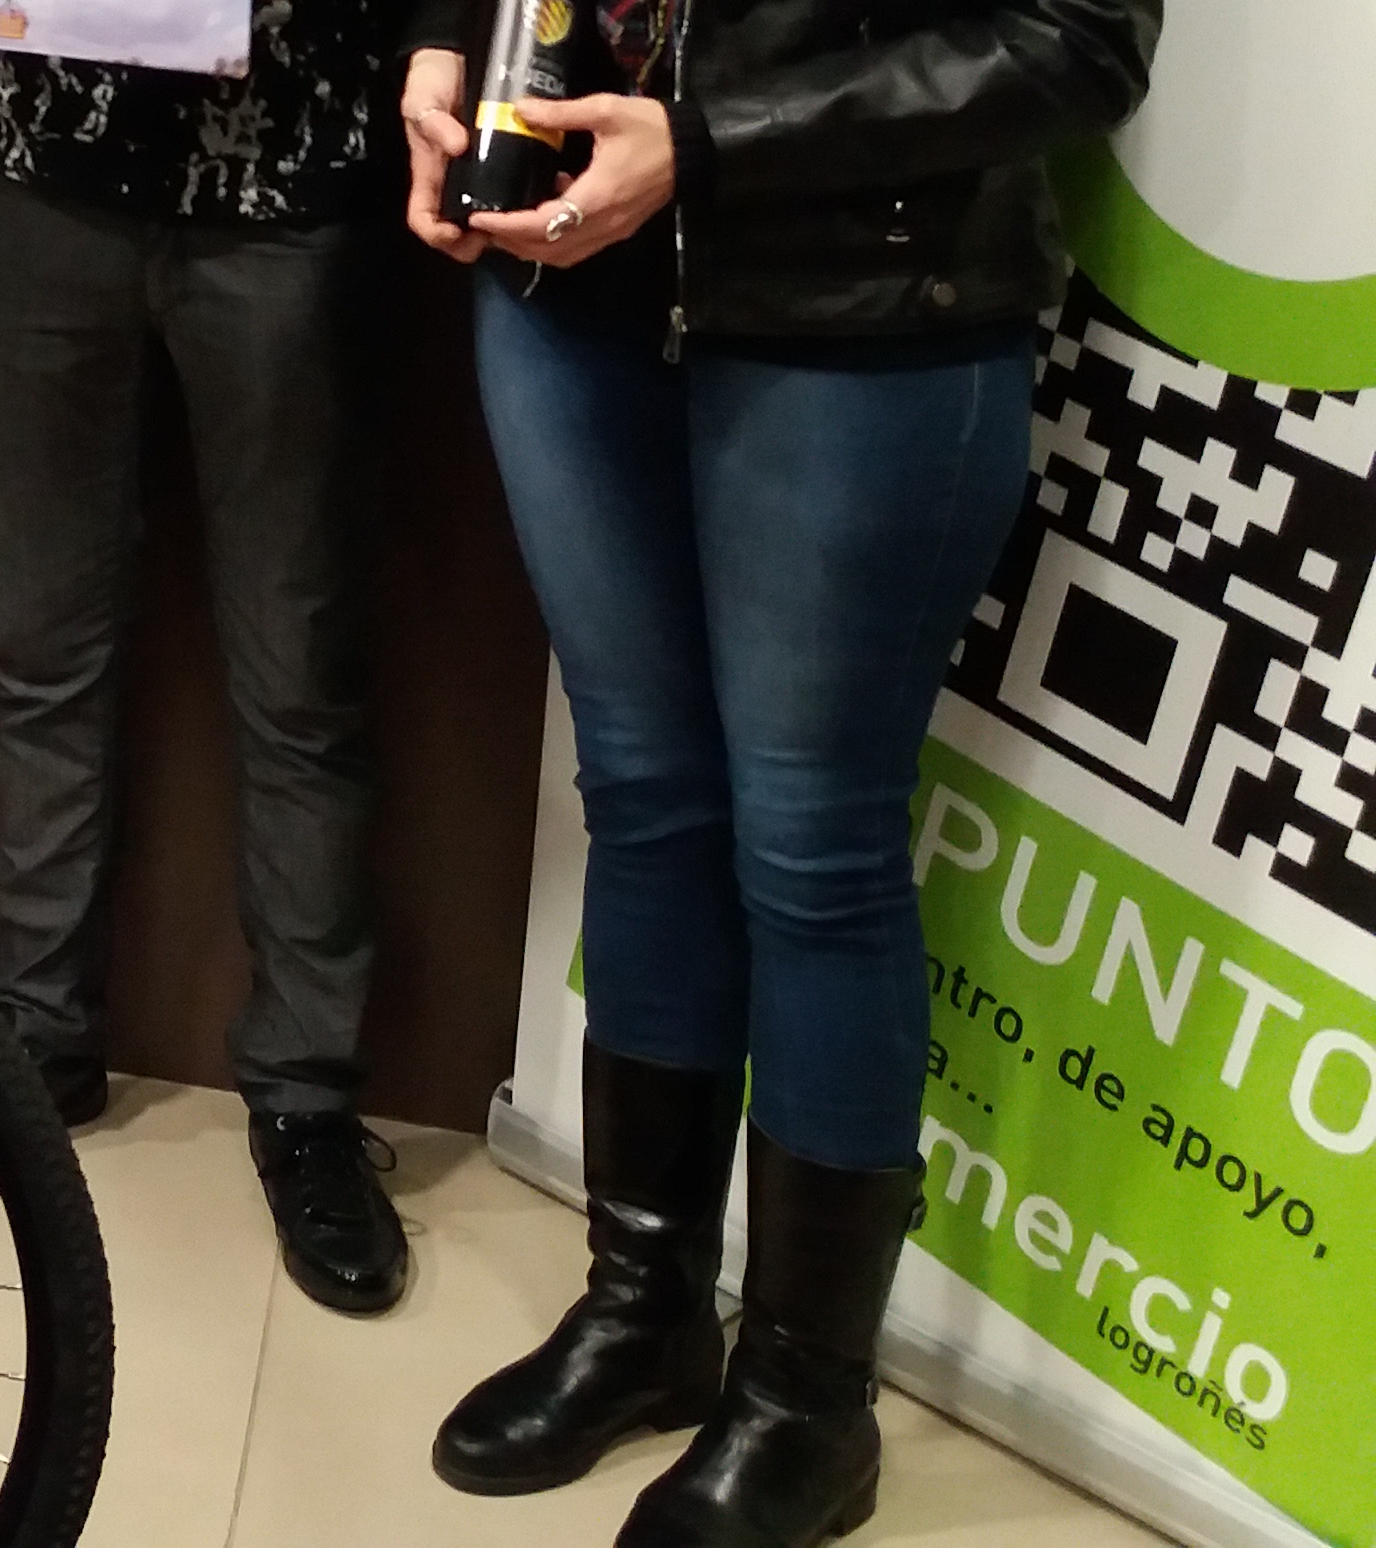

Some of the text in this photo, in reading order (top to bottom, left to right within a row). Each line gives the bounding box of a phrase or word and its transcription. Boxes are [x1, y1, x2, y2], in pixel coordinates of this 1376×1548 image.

[911, 782, 1376, 1155] PUNTO
[928, 954, 1328, 1260] ntro, de apoyo,
[916, 1114, 1291, 1423] mercio
[1096, 1304, 1269, 1453] logroñés
